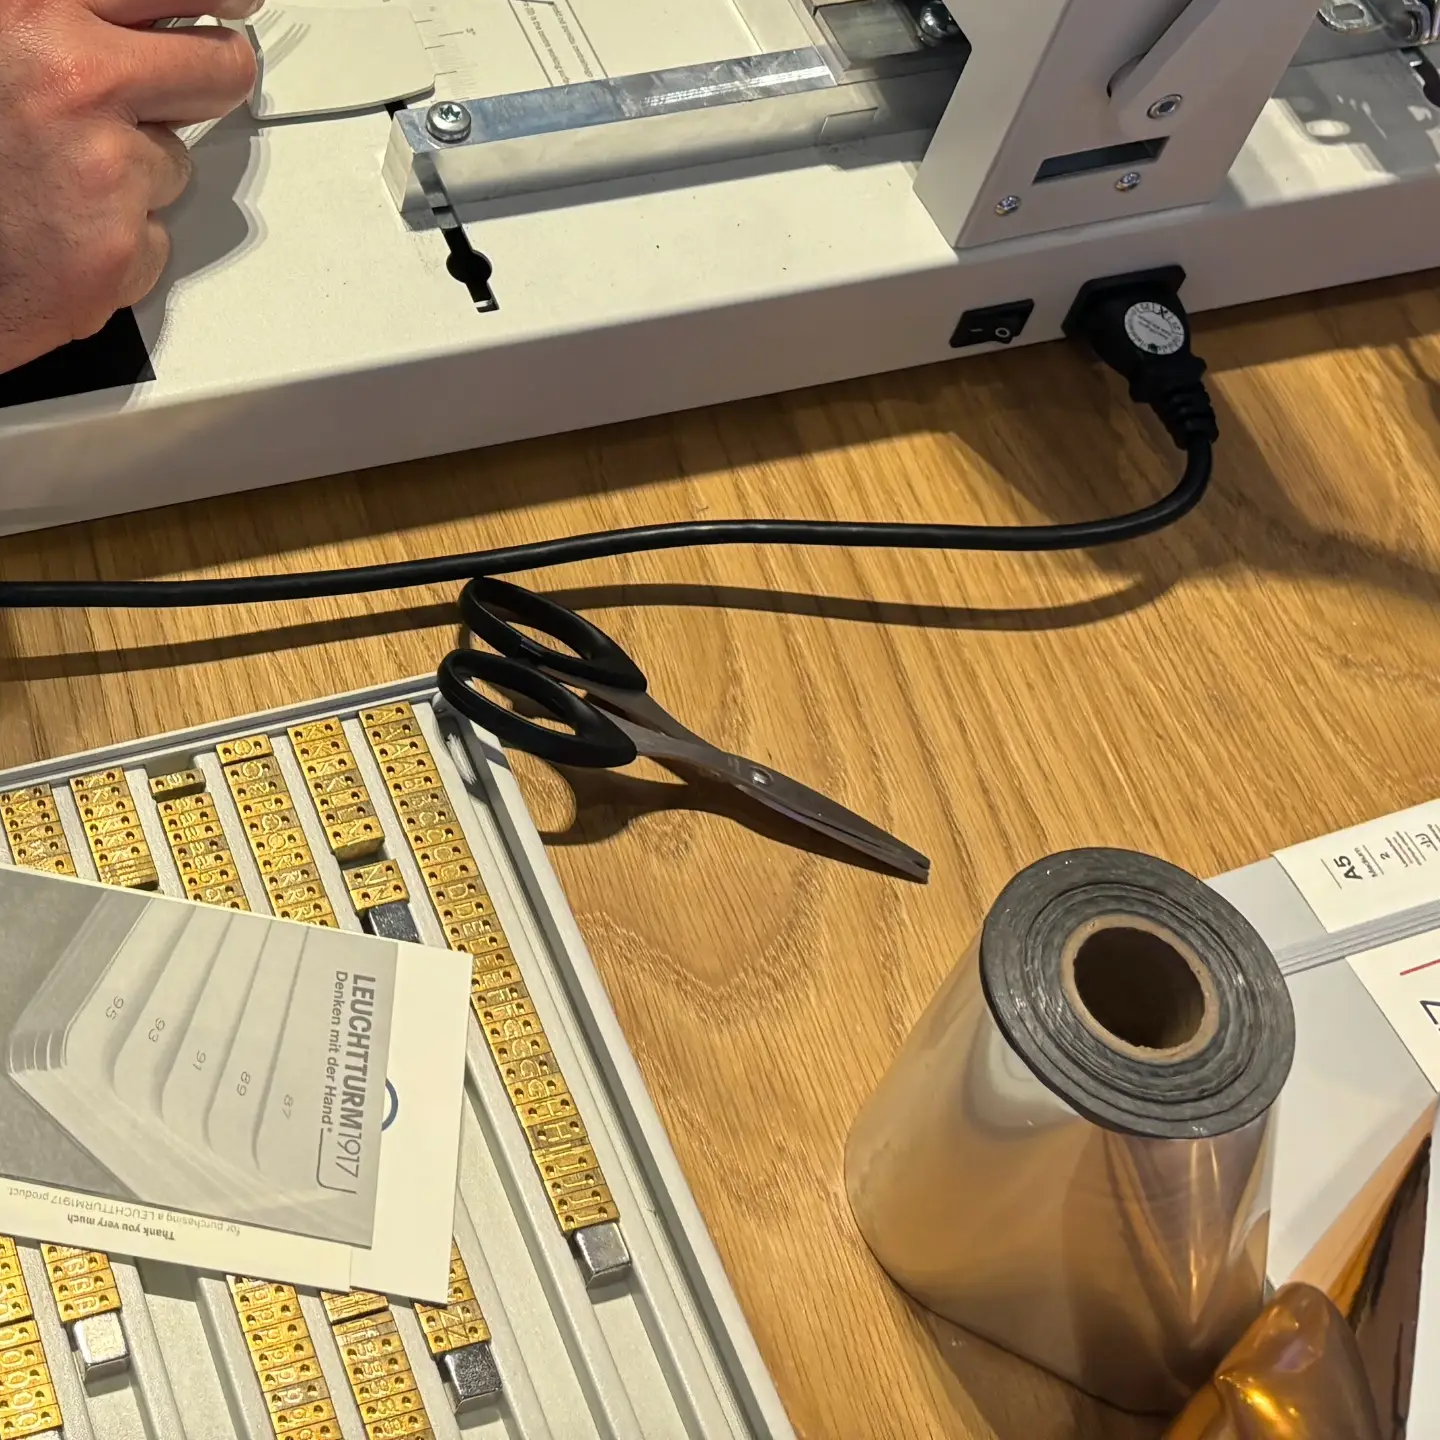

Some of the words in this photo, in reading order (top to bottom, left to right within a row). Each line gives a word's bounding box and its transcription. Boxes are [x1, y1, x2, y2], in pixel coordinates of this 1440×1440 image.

[1333, 855, 1364, 880] A5
[1354, 847, 1378, 878] Medium
[1379, 852, 1391, 860] 2
[105, 995, 124, 1020] 95
[328, 970, 348, 1026] Denken
[148, 1017, 166, 1043] 93
[327, 1027, 340, 1053] mit
[192, 1050, 207, 1071] 91
[325, 1056, 340, 1082] der
[236, 1071, 252, 1096] 89
[336, 973, 376, 1178] LEUCHTTURM1917
[281, 1094, 294, 1120] 87
[50, 1195, 156, 1221] LEUCHTTURM1917
[67, 1213, 96, 1225] much
[97, 1218, 120, 1230] very
[121, 1223, 141, 1235] you
[142, 1227, 176, 1241] Thank
[165, 1213, 224, 1232] purchasing
[228, 1225, 241, 1237] for
